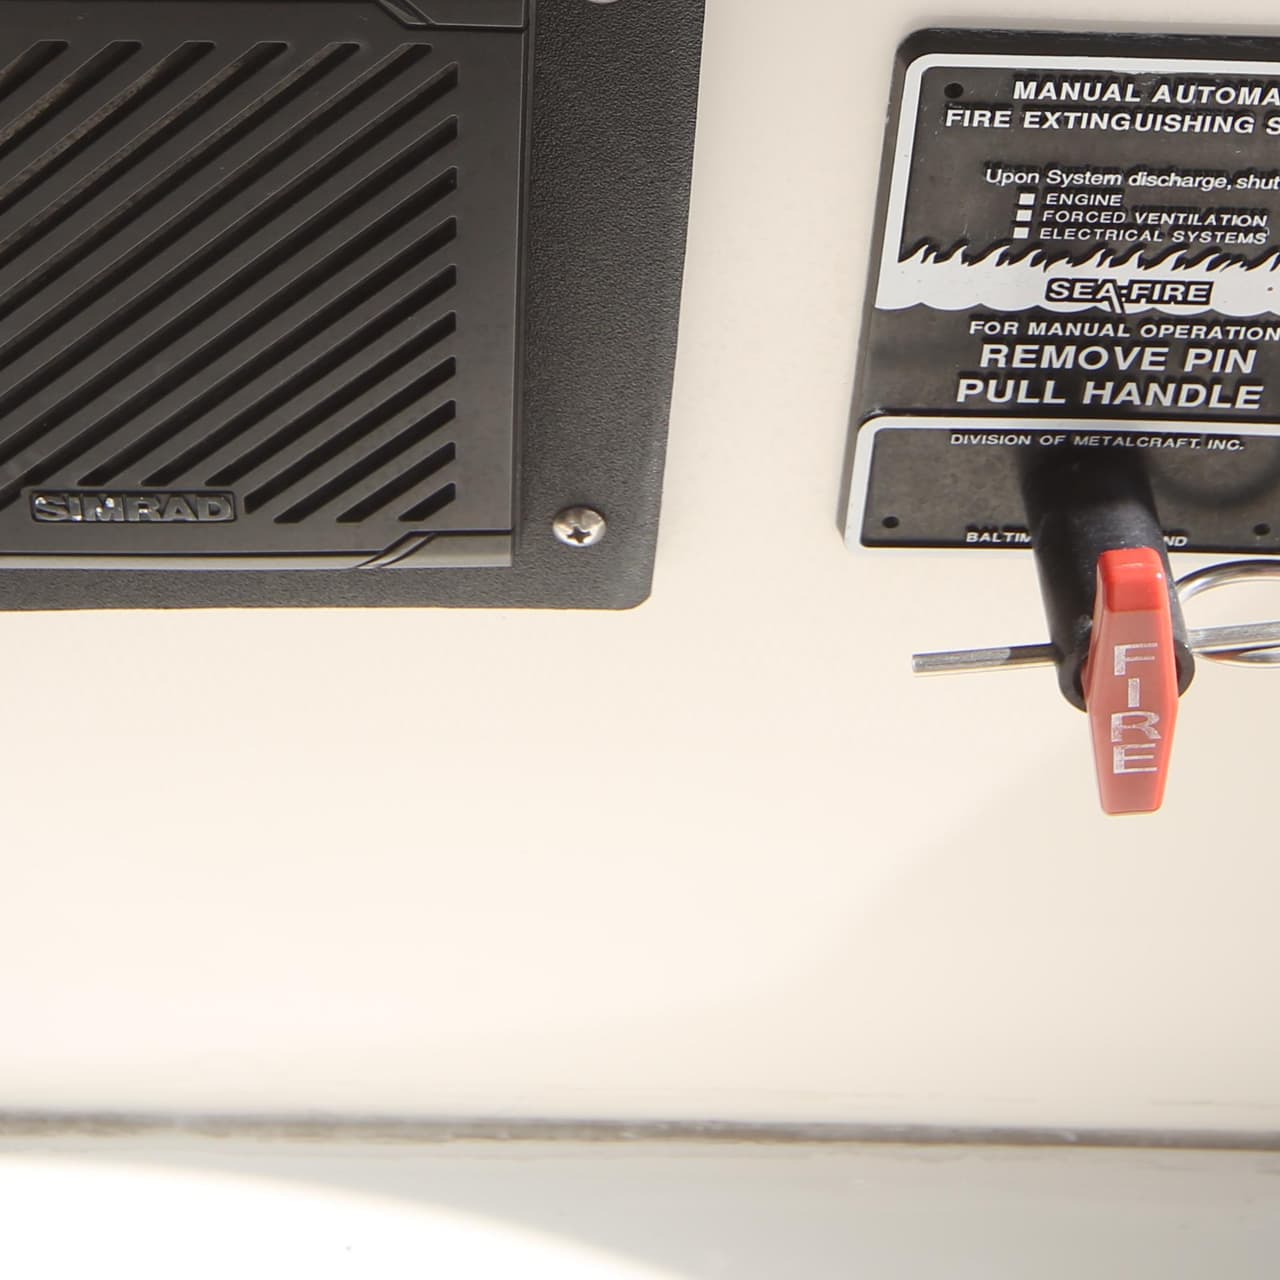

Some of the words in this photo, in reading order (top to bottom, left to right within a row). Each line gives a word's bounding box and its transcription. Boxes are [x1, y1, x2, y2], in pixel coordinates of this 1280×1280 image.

[1013, 81, 1141, 102] MANUAL
[945, 110, 1010, 128] FIRE
[1023, 111, 1255, 134] EXTINGUISHING
[985, 169, 1040, 189] Upon
[1046, 170, 1122, 189] System
[1128, 172, 1233, 192] discharge,
[1236, 174, 1280, 191] shut
[1046, 193, 1122, 206] ENGINE
[1042, 210, 1126, 224] FORCED
[1134, 212, 1267, 227] VENTILATION
[1040, 227, 1163, 242] ELECTRICAL
[1172, 230, 1268, 244] SYSTEMS
[969, 321, 1018, 336] FOR
[1028, 322, 1130, 338] MANUAL
[979, 343, 1169, 372] REMOVE
[1183, 348, 1257, 373] PIN
[956, 378, 1066, 404] PULL
[1082, 381, 1264, 409] HANDLE
[951, 434, 1032, 446] DIVISION
[1040, 435, 1066, 446] OF
[1206, 439, 1244, 450] INC.
[34, 495, 233, 521] SIMRAD
[1110, 642, 1161, 775] FIRE
